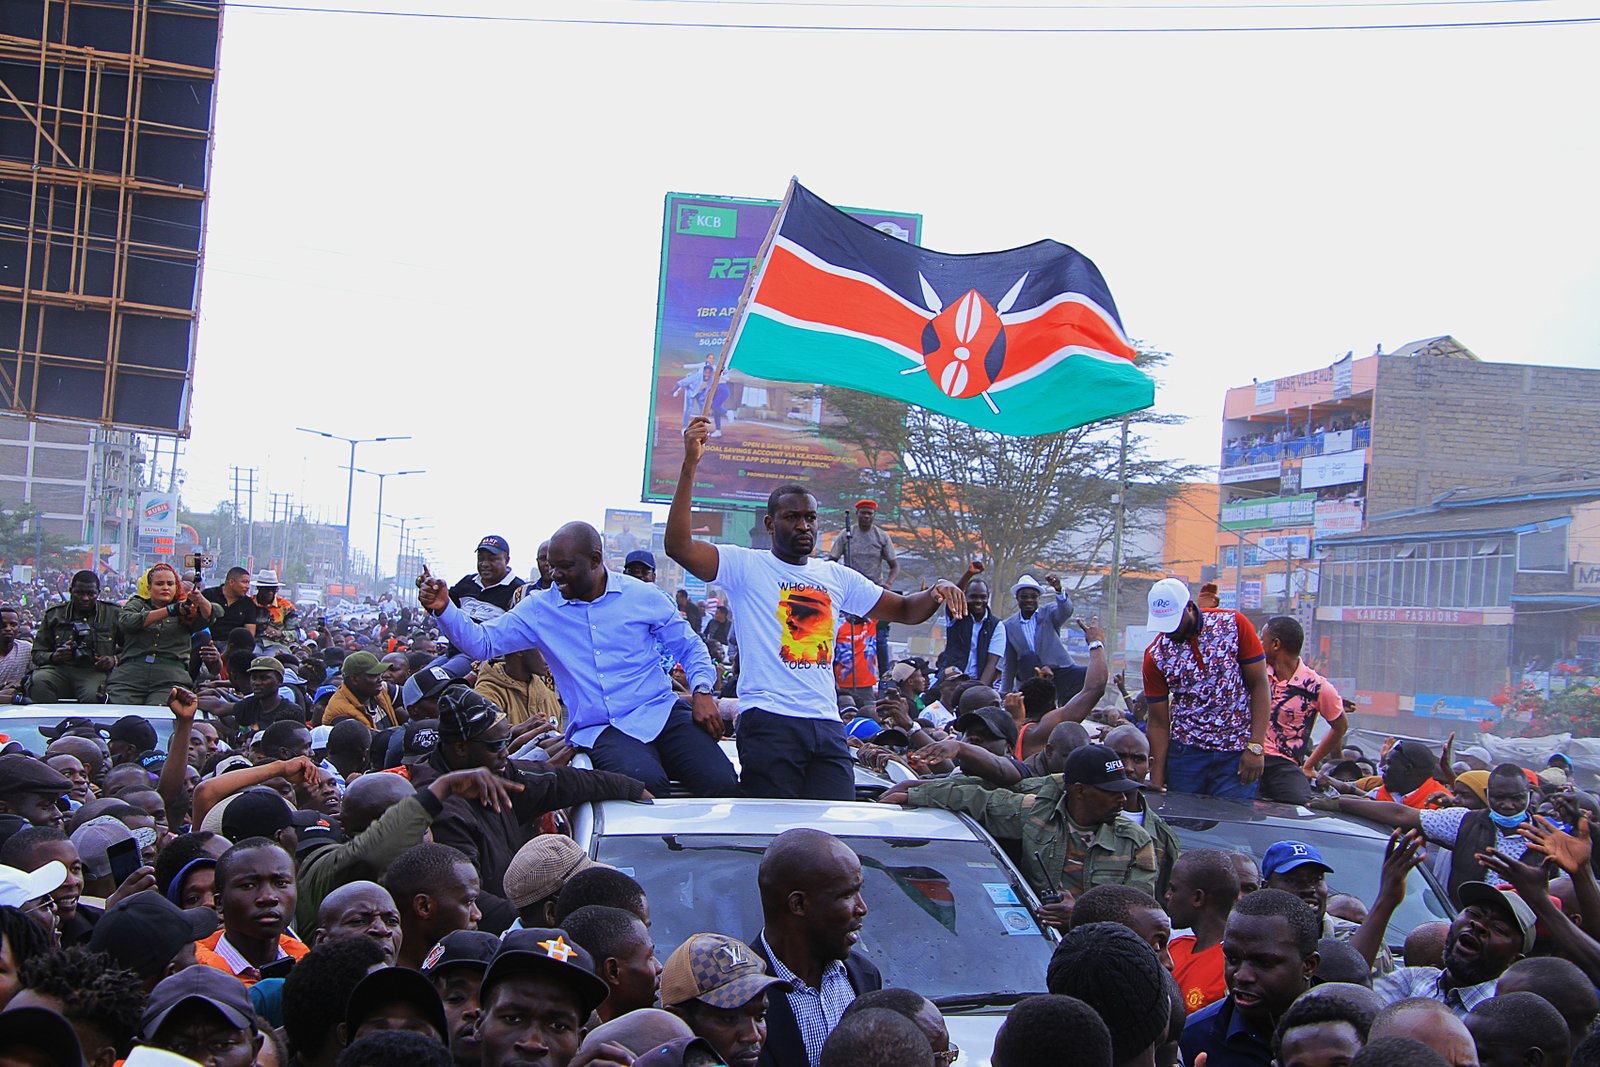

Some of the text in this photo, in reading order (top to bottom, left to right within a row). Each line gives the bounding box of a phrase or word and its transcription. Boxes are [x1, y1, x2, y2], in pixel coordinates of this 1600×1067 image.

[697, 215, 721, 228] KCB
[697, 307, 717, 317] 1BR
[723, 447, 752, 455] SAVINGS
[752, 449, 784, 457] ACCOUNT
[147, 504, 168, 515] RUBIS
[778, 581, 806, 592] WHO
[1405, 610, 1459, 622] FASHIONS
[1290, 844, 1308, 856] E
[545, 939, 572, 963] H
